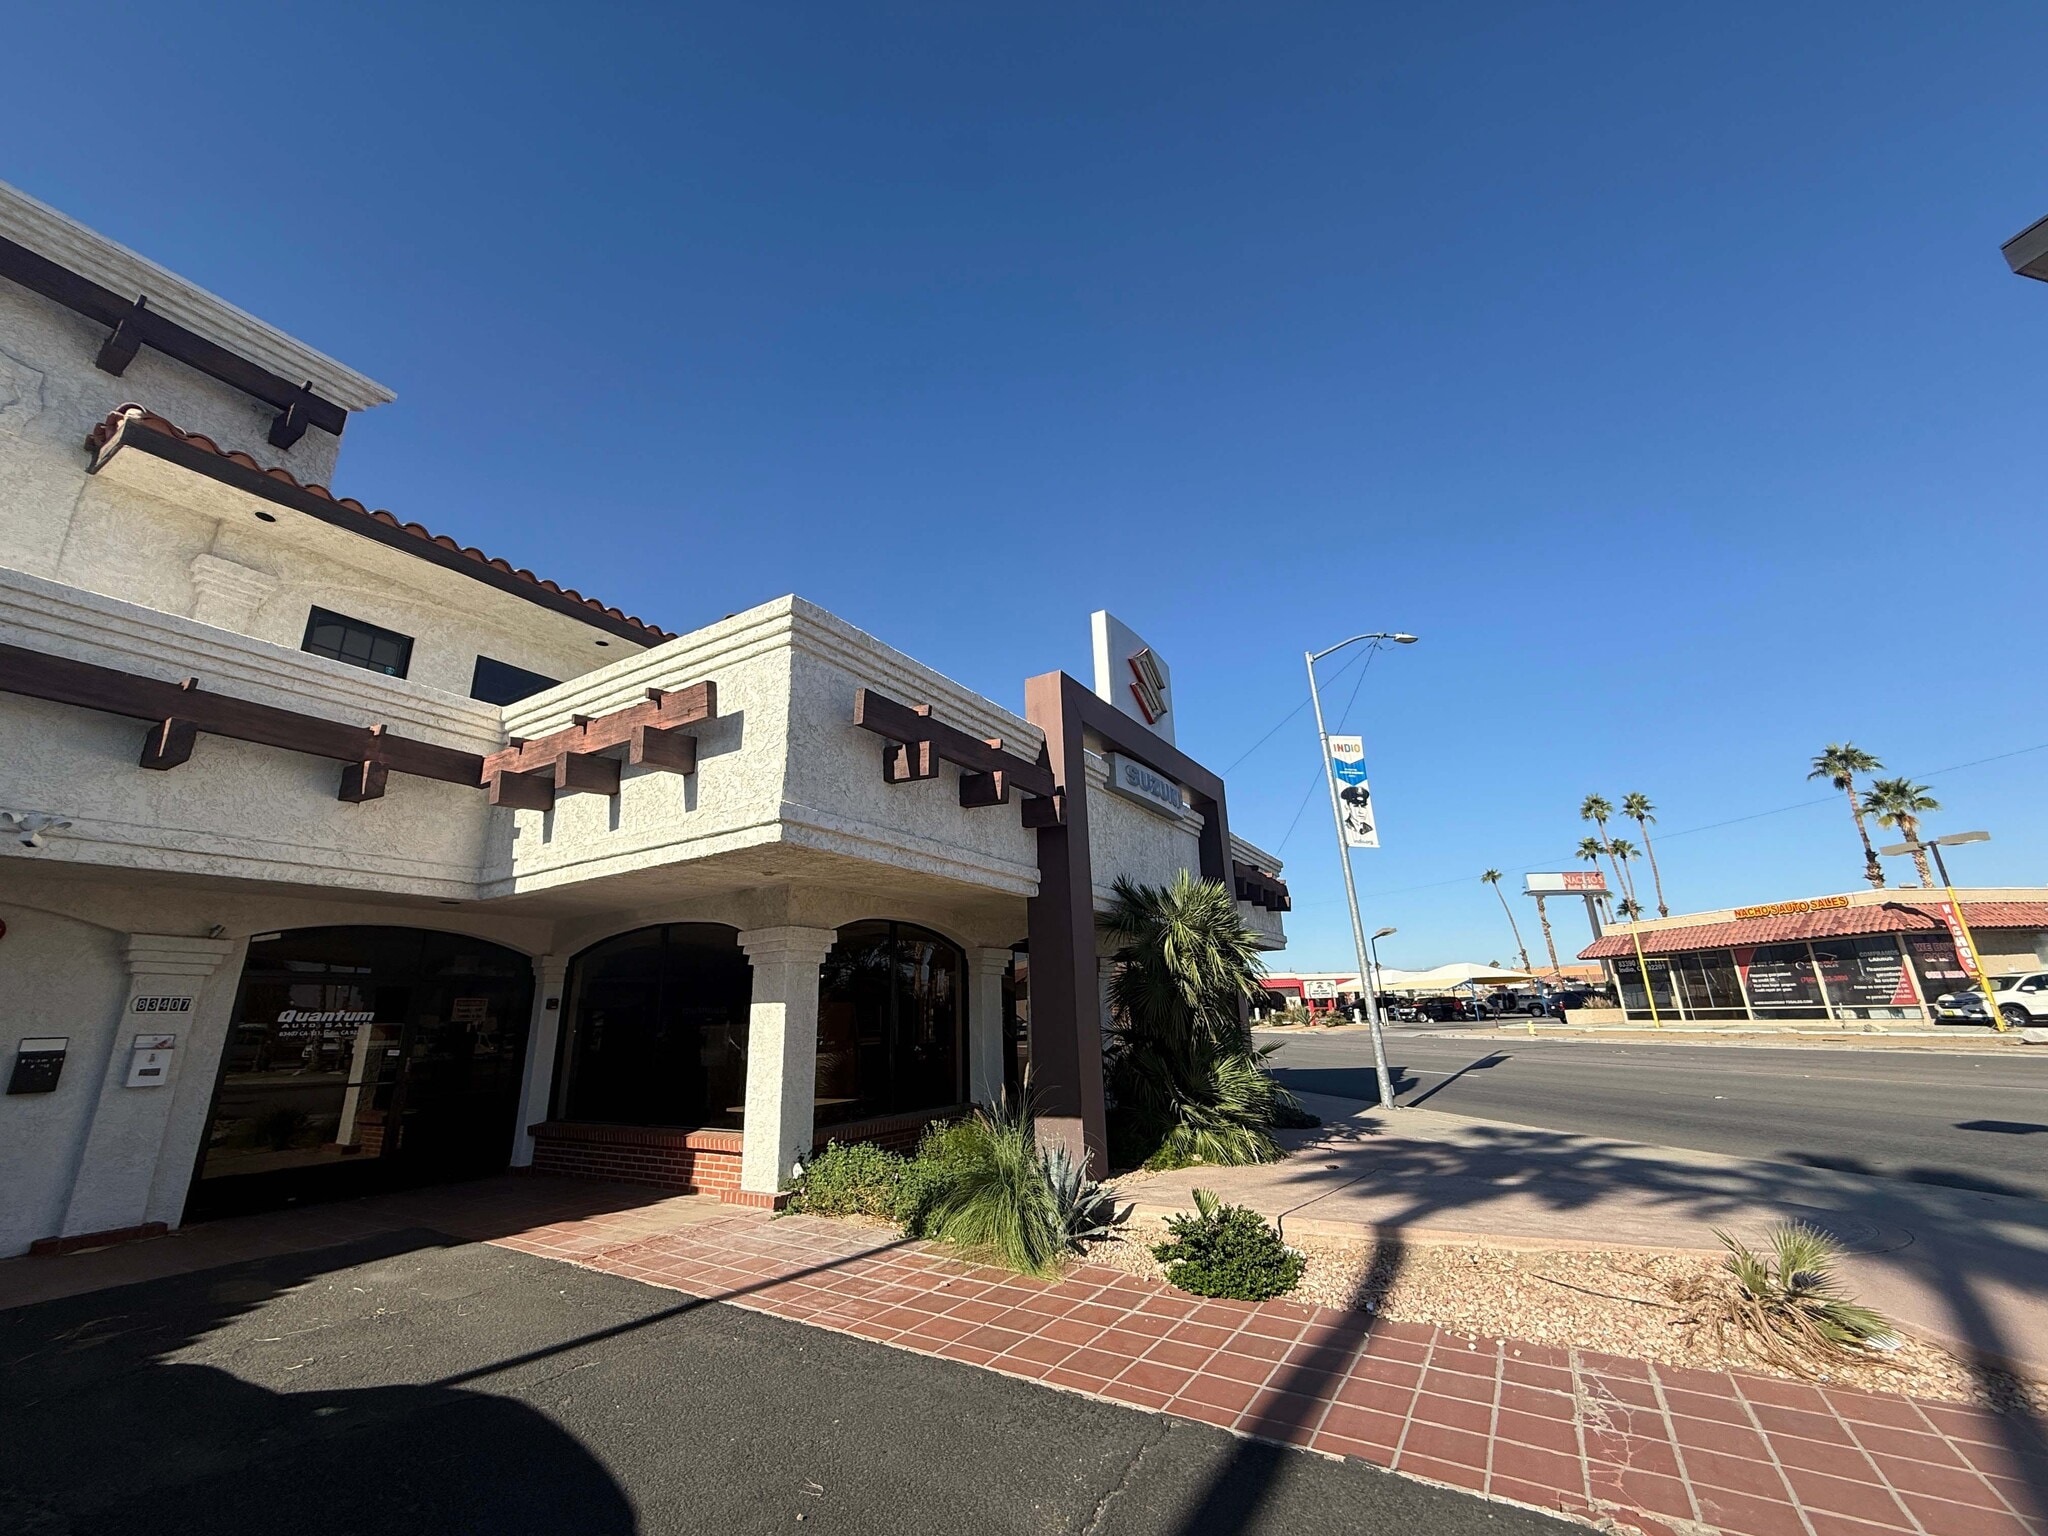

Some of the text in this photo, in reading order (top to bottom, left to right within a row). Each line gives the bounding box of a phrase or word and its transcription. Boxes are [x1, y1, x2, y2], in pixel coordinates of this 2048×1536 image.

[1125, 764, 1181, 810] SUZUKI
[1734, 896, 1848, 919] NACHO'S AUTO SALES
[1941, 904, 1977, 969] NACHOS
[1913, 943, 1933, 952] WE
[137, 998, 190, 1011] 83407
[277, 1010, 375, 1022] Quantum
